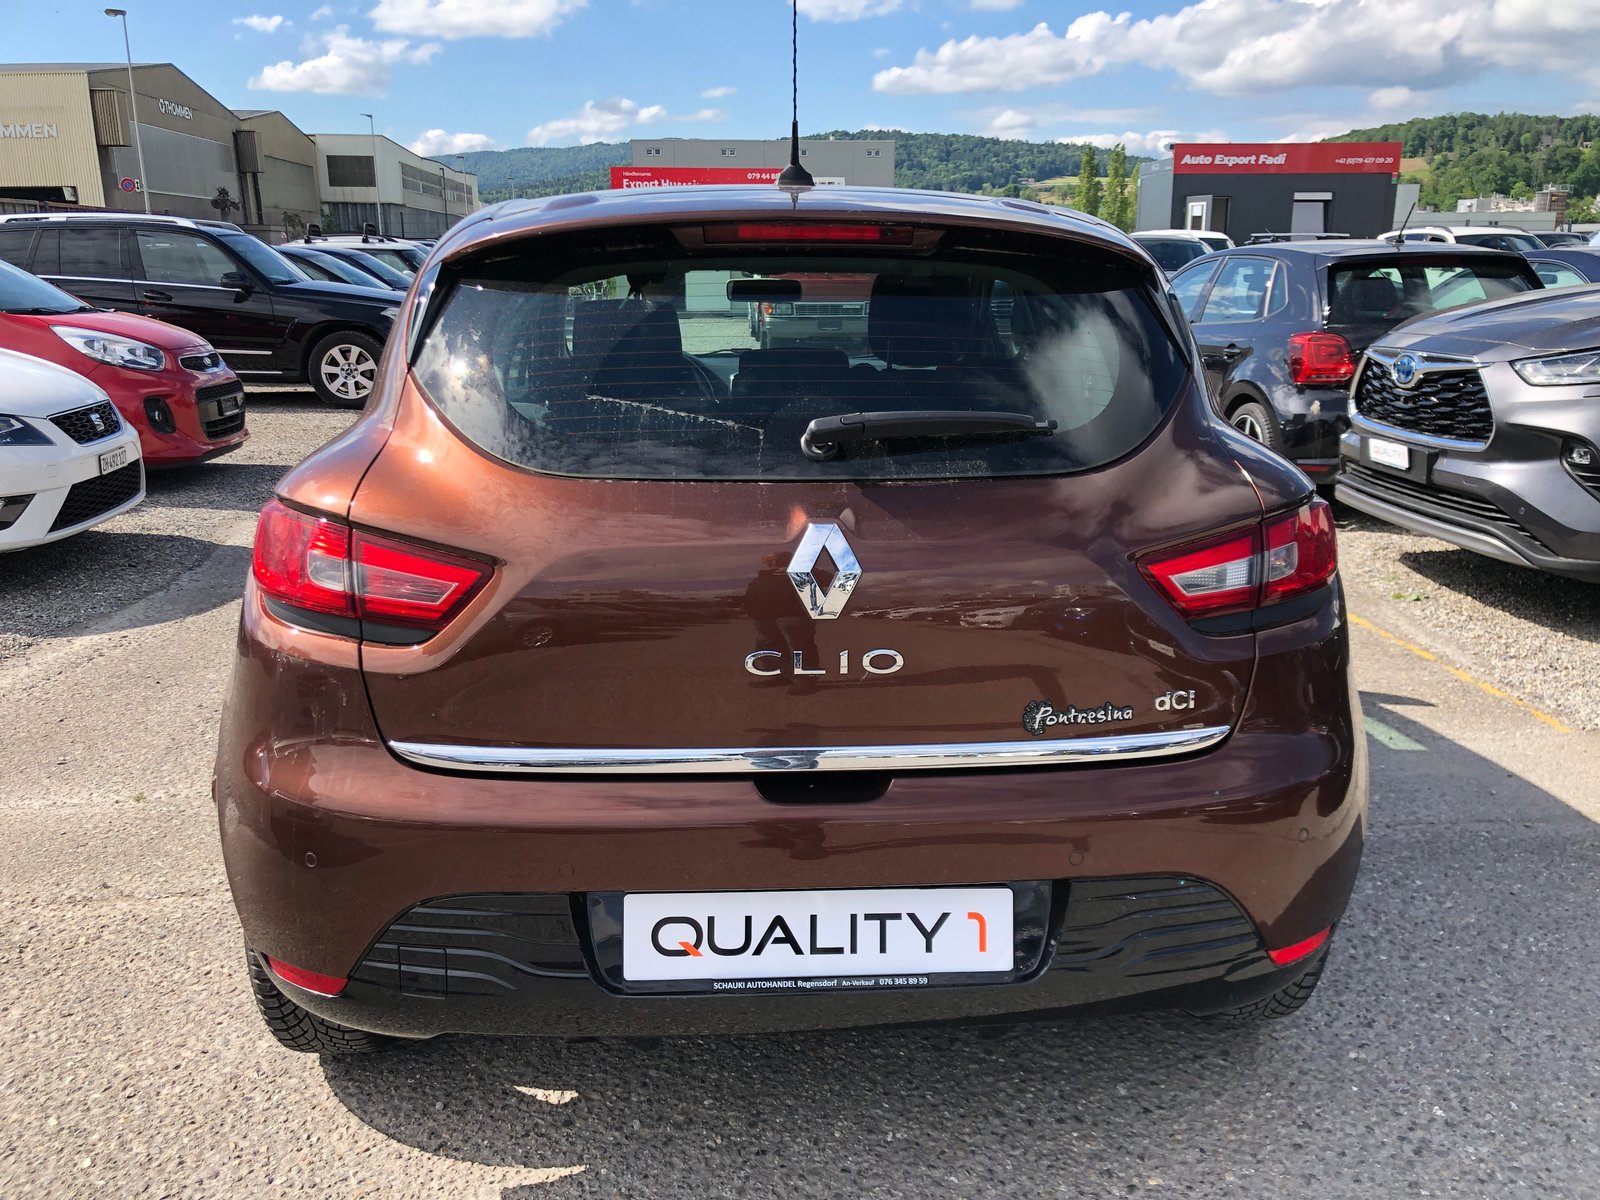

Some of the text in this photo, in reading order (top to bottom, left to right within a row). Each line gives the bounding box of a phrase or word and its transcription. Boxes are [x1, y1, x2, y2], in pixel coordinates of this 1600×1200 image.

[1181, 153, 1288, 167] Auto Export Fadi
[622, 178, 659, 189] Export
[747, 172, 761, 180] 079
[761, 172, 770, 180] 44
[744, 648, 904, 676] CLIO
[1155, 689, 1195, 711] dCi
[1034, 703, 1134, 729] Pontresina
[651, 911, 987, 957] QUALITY 1
[713, 976, 928, 990] SCHAUKI AUTOHANDEL Regensdorf An-Verkauf 076 345 89 59
